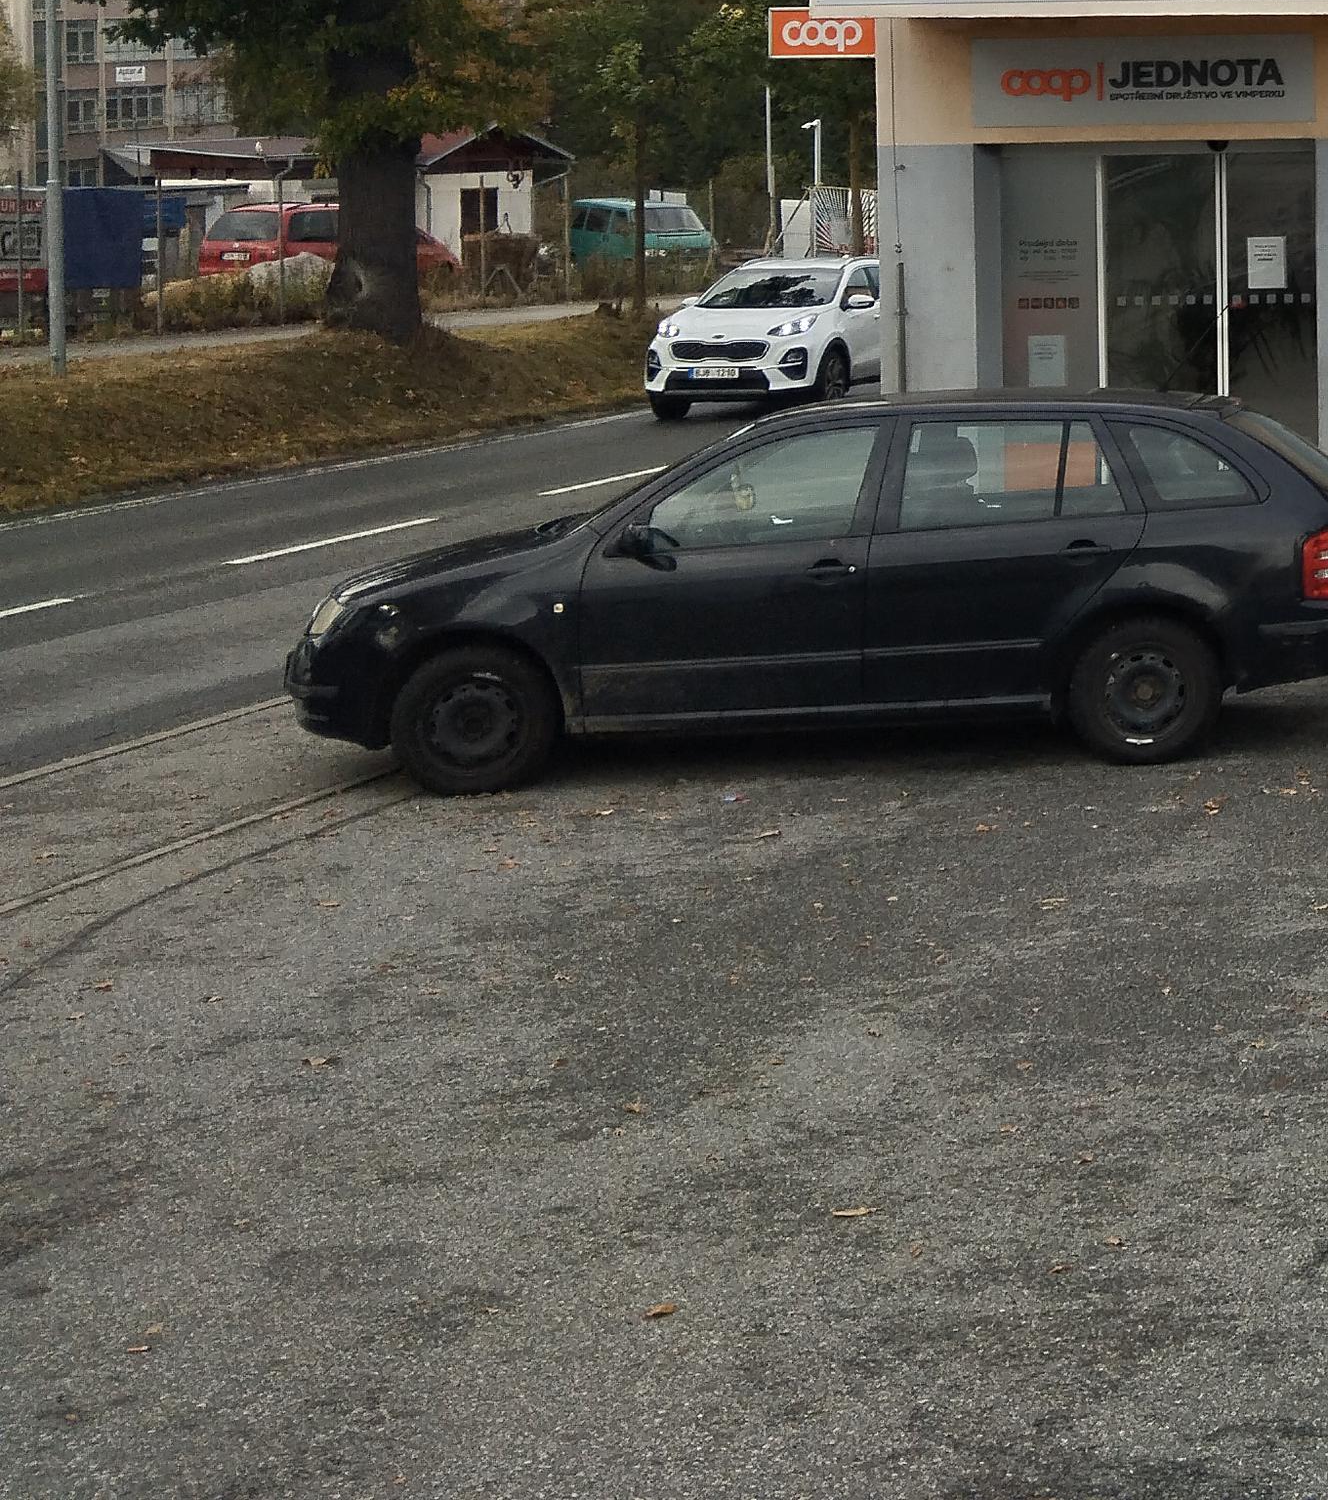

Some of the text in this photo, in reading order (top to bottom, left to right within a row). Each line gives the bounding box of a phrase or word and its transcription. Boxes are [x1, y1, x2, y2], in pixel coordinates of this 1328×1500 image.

[781, 19, 864, 52] coop
[1000, 57, 1284, 102] coop JEDNOTA
[1109, 88, 1285, 100] SPOTŘEBNÍ DRUŽSTVO VE VIMPERKU
